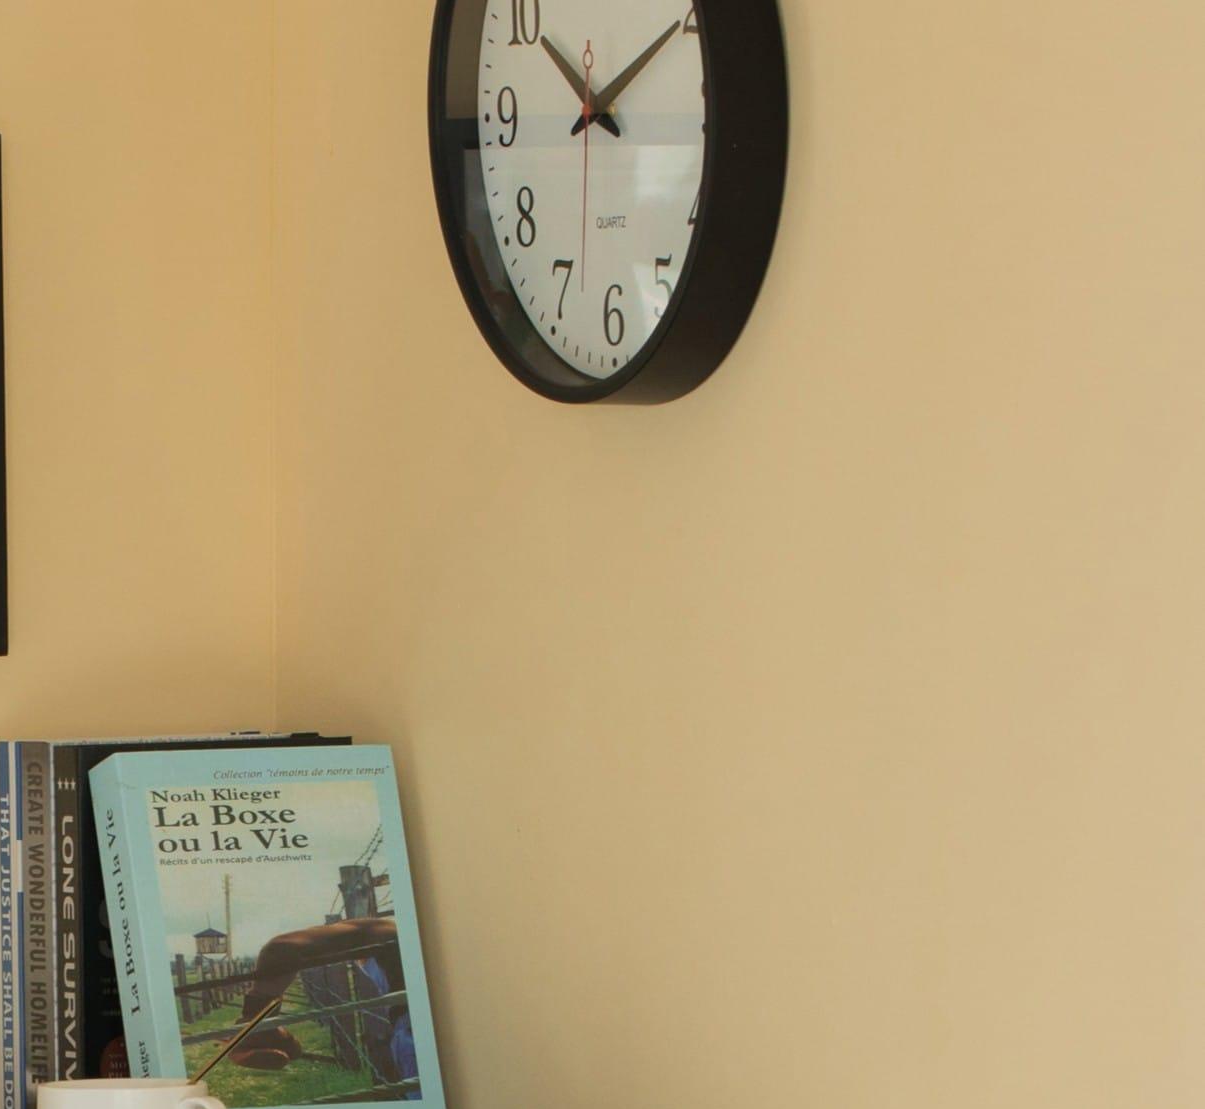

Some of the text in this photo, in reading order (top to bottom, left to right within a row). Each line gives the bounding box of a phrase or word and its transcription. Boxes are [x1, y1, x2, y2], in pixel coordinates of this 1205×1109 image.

[508, 0, 540, 46] 10
[497, 86, 518, 148] 9
[515, 186, 536, 248] 8
[596, 215, 627, 230] QUARTZ
[551, 259, 574, 320] 7
[603, 284, 625, 346] 6
[654, 253, 675, 319] 5
[150, 787, 281, 804] Noah Klieger
[213, 769, 263, 780] Collection
[311, 767, 323, 777] de
[326, 768, 353, 777] notre
[0, 793, 10, 856] THAT
[153, 803, 296, 828] La Boxe
[158, 827, 310, 854] ou la Vie
[159, 853, 312, 867] Récits d'un rescapé d'Auschwitz
[1, 866, 11, 961] JUSTICE
[26, 761, 49, 1085] CREATE WONDERFUL HOMELIFE
[105, 808, 141, 1016] La Boxe ou la Vie
[61, 815, 78, 1082] LONE SURVIV
[2, 972, 13, 1039] SHALL
[4, 1047, 14, 1073] BE
